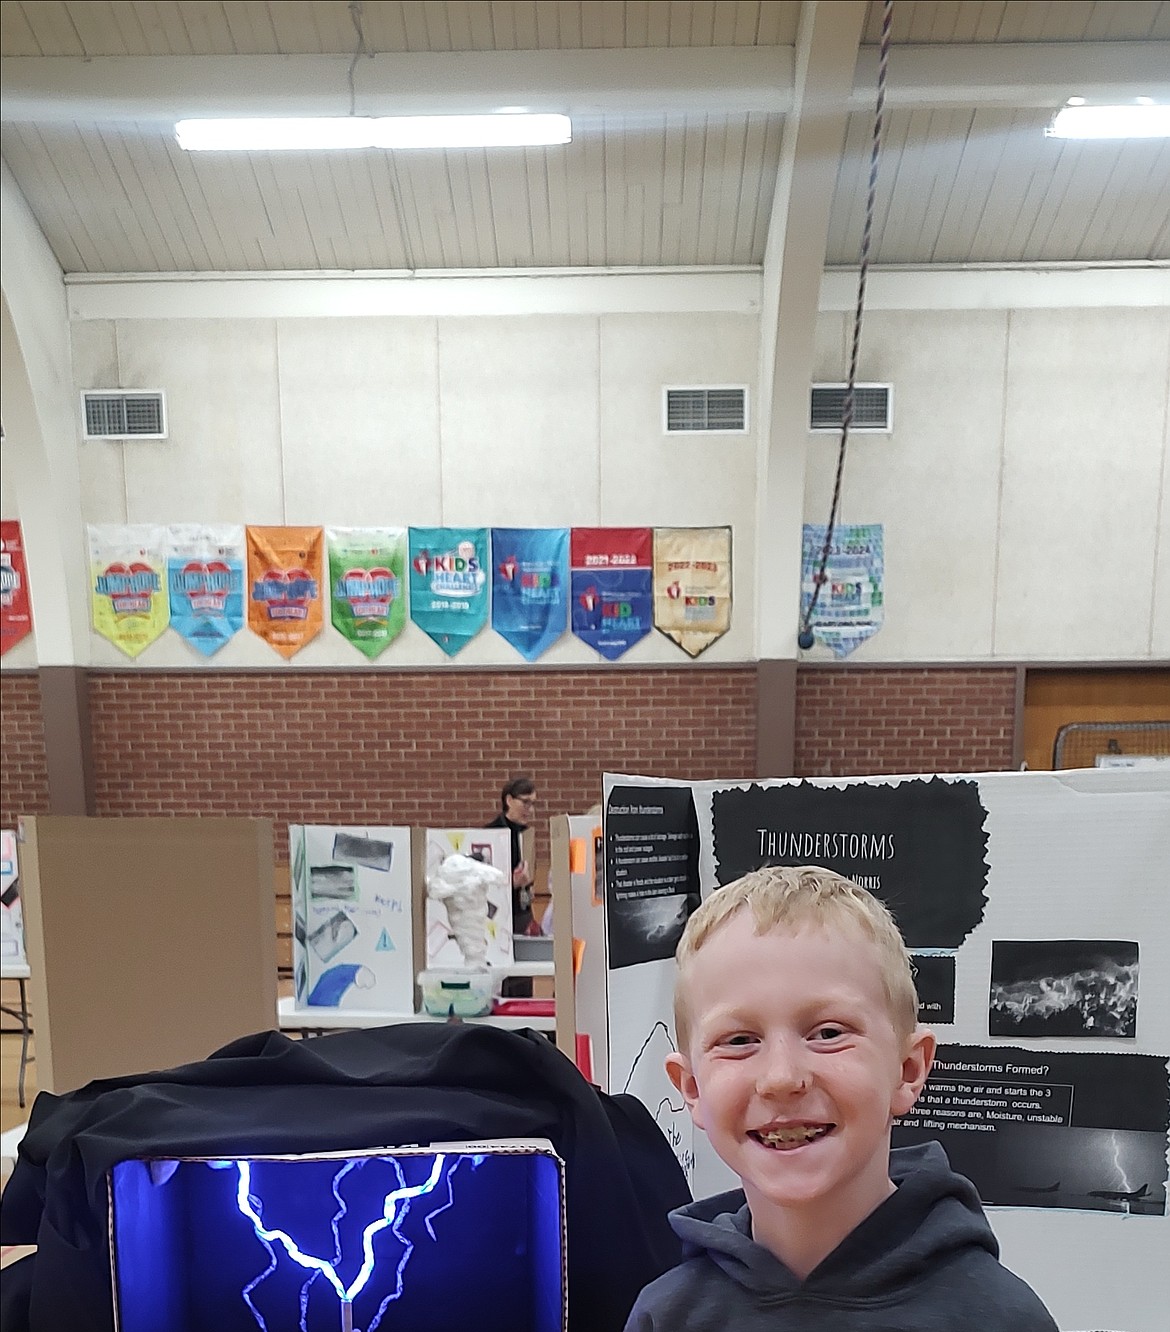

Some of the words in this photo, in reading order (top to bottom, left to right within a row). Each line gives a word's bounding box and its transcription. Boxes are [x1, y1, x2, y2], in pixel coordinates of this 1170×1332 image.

[434, 556, 478, 572] KIDS
[933, 1060, 1003, 1073] Thunderstorms
[1005, 1064, 1049, 1075] Formed?
[929, 1084, 956, 1092] warms
[958, 1084, 971, 1093] the
[1004, 1087, 1027, 1096] starts
[1029, 1088, 1043, 1097] the
[1045, 1088, 1051, 1097] 3
[927, 1095, 943, 1103] that
[952, 1097, 1007, 1107] thunderstorm
[1012, 1101, 1042, 1109] occurs.
[910, 1106, 931, 1115] three
[933, 1109, 966, 1117] reasons
[968, 1111, 984, 1120] are,
[986, 1111, 1025, 1122] Moisture,
[1027, 1115, 1063, 1123] unstable
[923, 1119, 945, 1130] lifting
[947, 1122, 996, 1132] mechanism.
